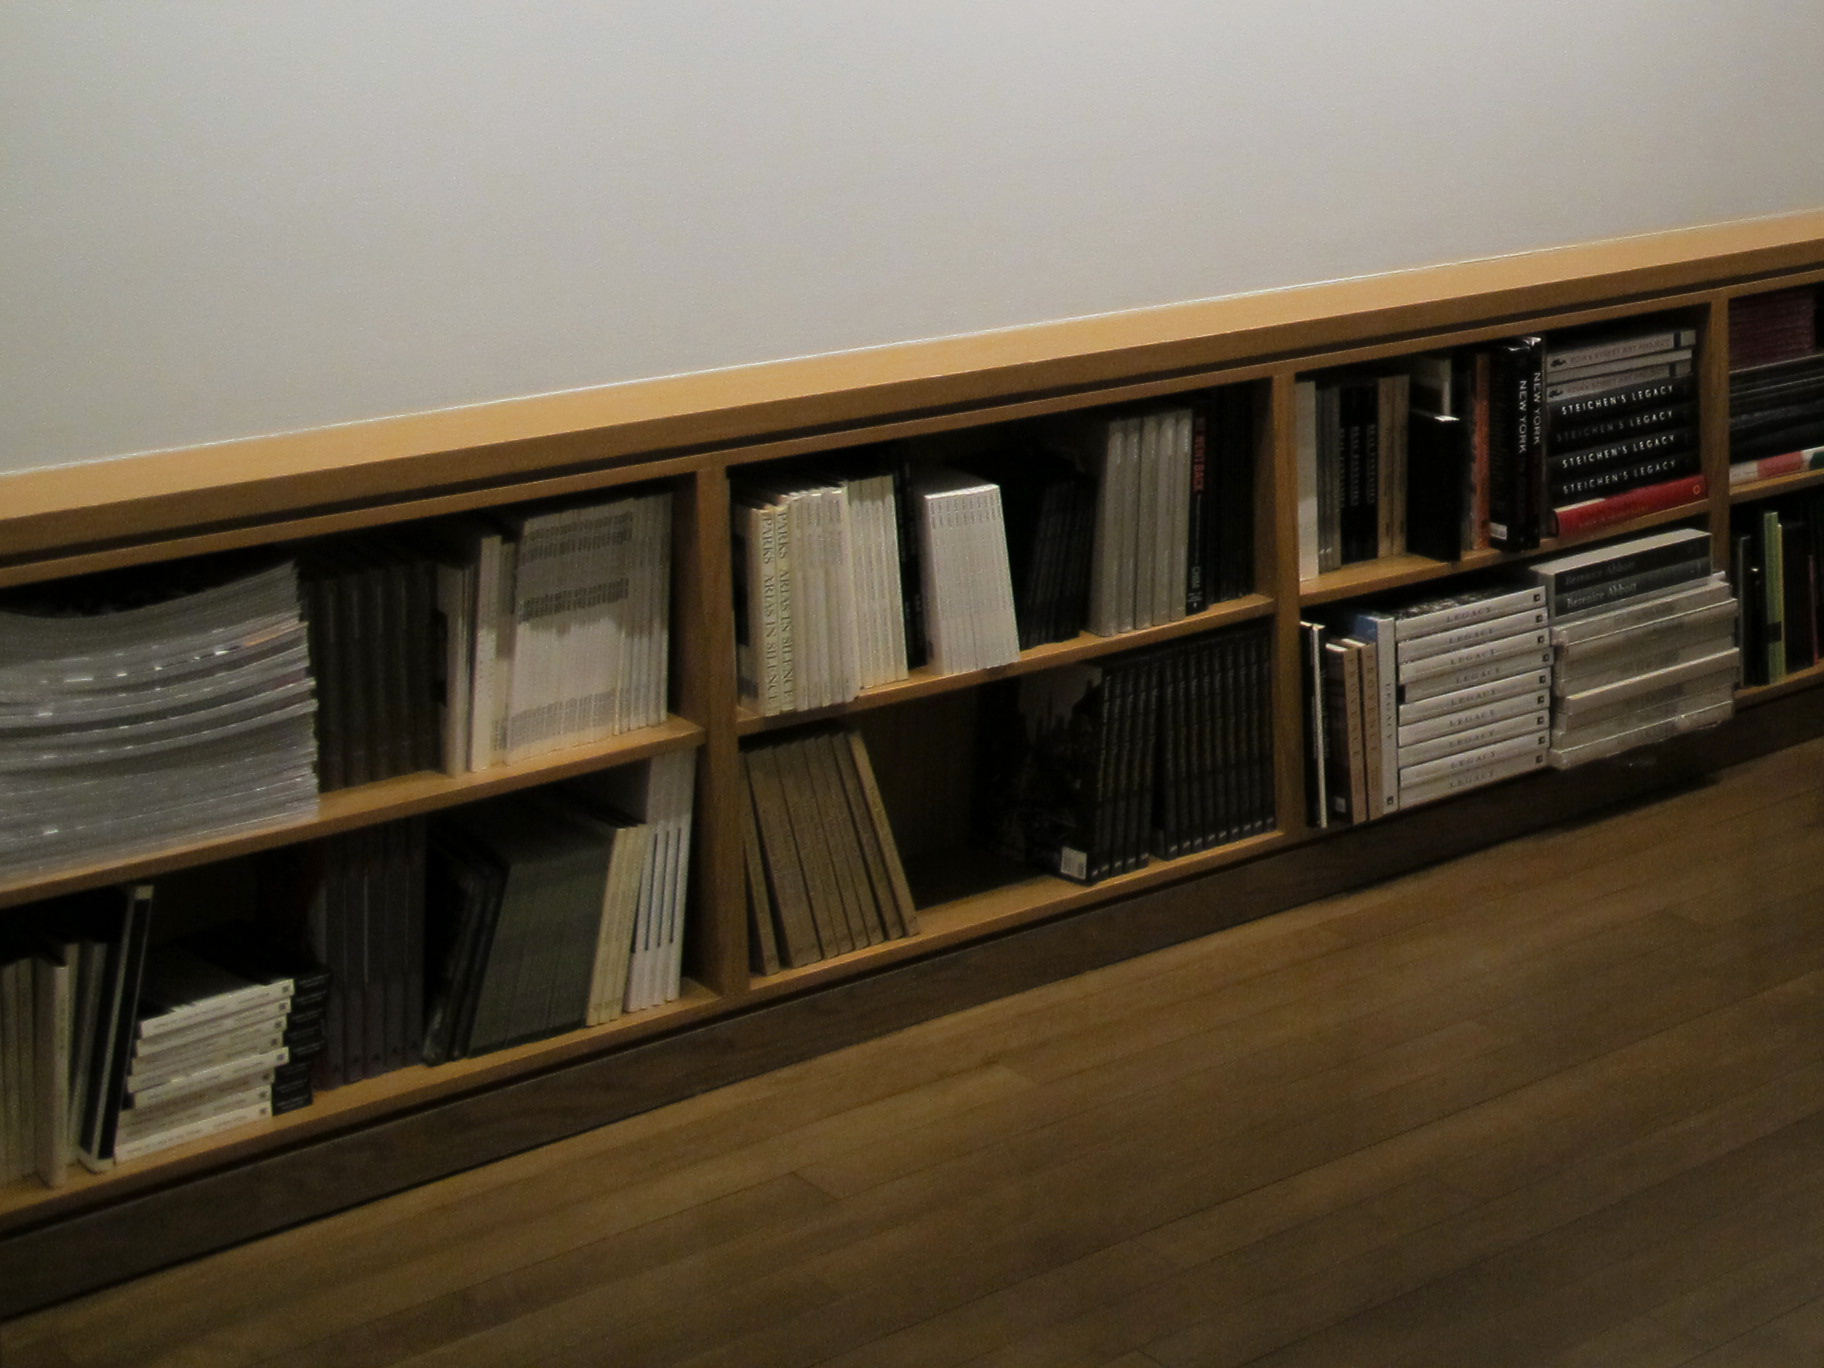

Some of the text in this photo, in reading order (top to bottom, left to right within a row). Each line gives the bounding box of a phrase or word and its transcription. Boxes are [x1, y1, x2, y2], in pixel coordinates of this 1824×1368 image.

[1518, 380, 1527, 411] NEW
[1561, 384, 1674, 416] STEICHEN'S LEGACY
[1533, 372, 1542, 445] NEW YORK
[1630, 410, 1674, 428] LEGACY
[1518, 415, 1527, 455] YORK
[1561, 434, 1676, 469] STEICHEN'S LEGACY
[1562, 460, 1677, 495] STEICHEN'S LEGACY
[777, 512, 788, 560] PARKS
[779, 568, 790, 611] ARIAS
[762, 517, 779, 702] PARKS ARIAS IN SILENCE
[1446, 606, 1493, 623] LEGACY
[1449, 627, 1494, 644] LEGACY
[781, 637, 794, 698] SILENCE
[1450, 649, 1495, 665] LEGACY
[1455, 668, 1500, 684] LEGACY
[1451, 689, 1496, 706] LEGACY
[1449, 710, 1495, 727] LEGACY
[1449, 730, 1495, 747] LEGACY
[1450, 751, 1496, 769] LEGACY
[1449, 771, 1494, 788] LEGACY
